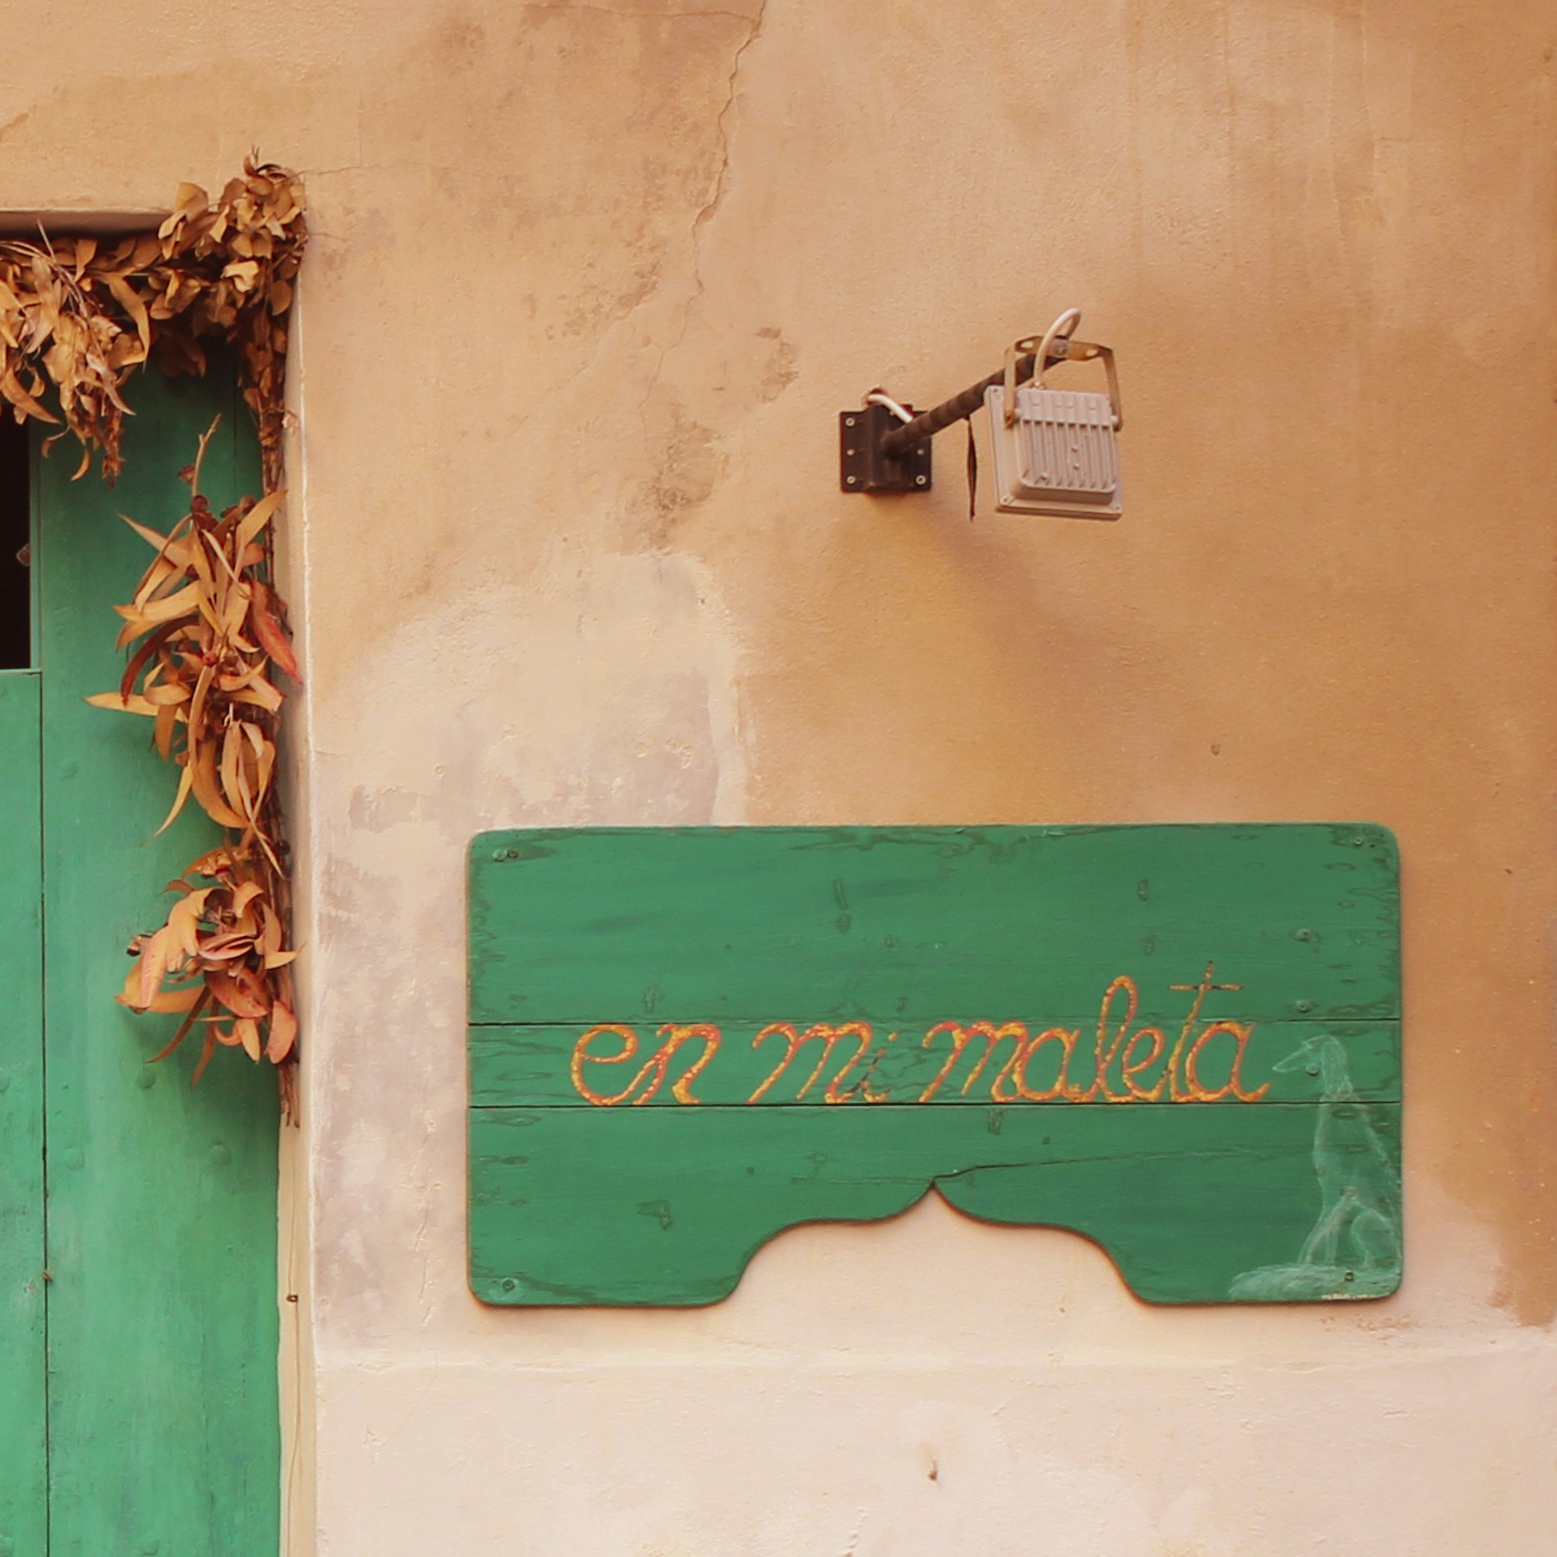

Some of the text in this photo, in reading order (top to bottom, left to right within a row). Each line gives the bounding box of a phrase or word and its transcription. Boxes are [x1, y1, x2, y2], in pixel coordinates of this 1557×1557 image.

[571, 961, 1271, 1106] en mi maleta
